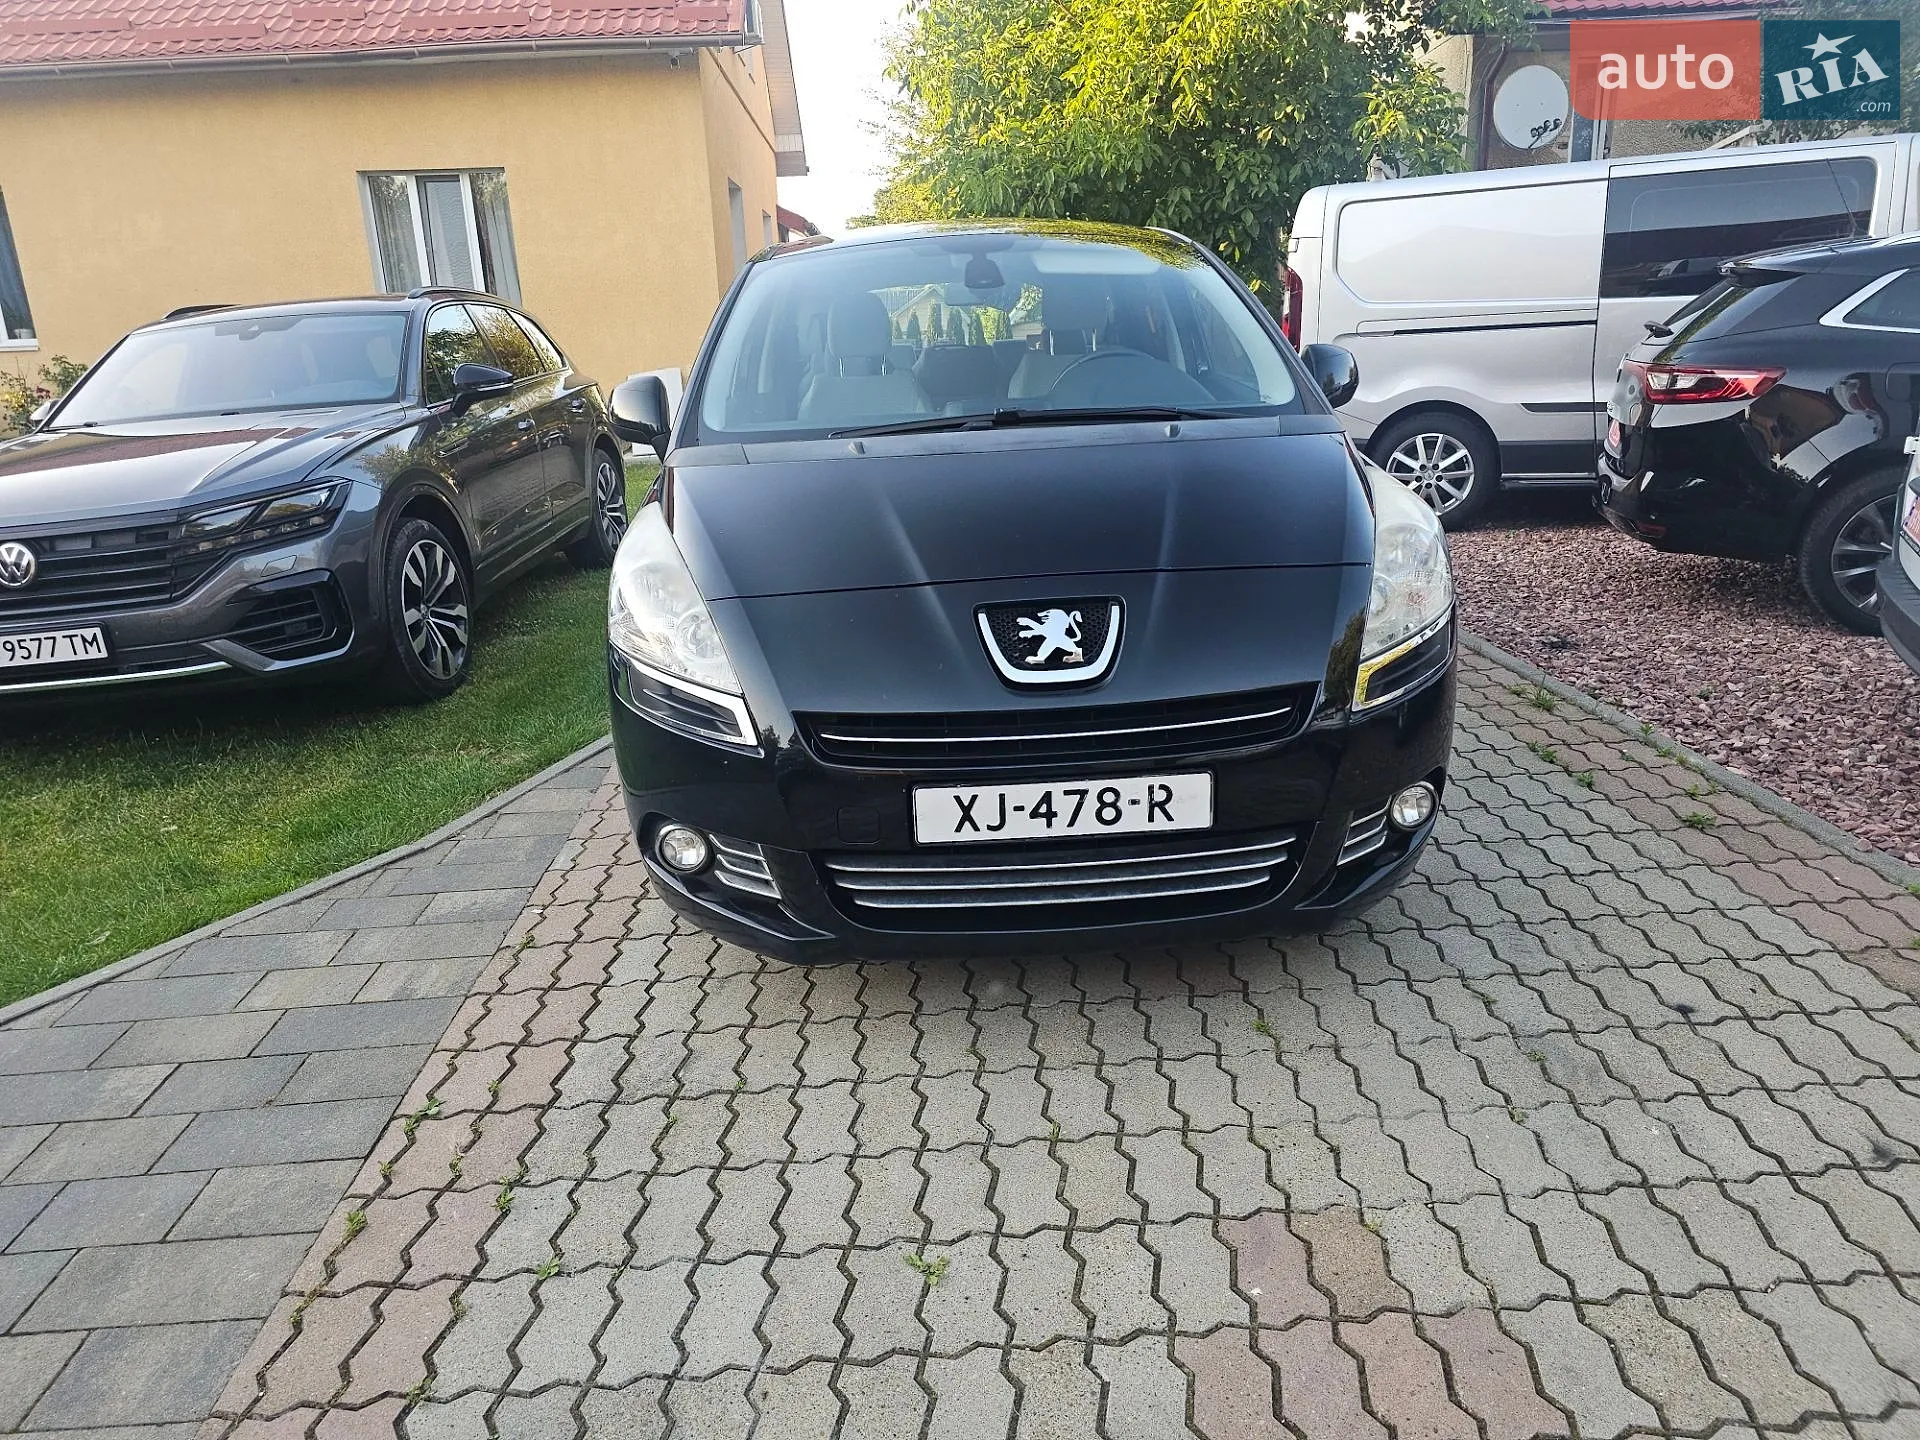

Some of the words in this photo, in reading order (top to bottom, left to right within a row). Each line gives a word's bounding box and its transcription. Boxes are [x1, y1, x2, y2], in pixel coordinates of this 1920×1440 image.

[2, 636, 57, 661] 9577
[62, 632, 102, 656] TM
[953, 783, 1175, 833] XJ-478-R
